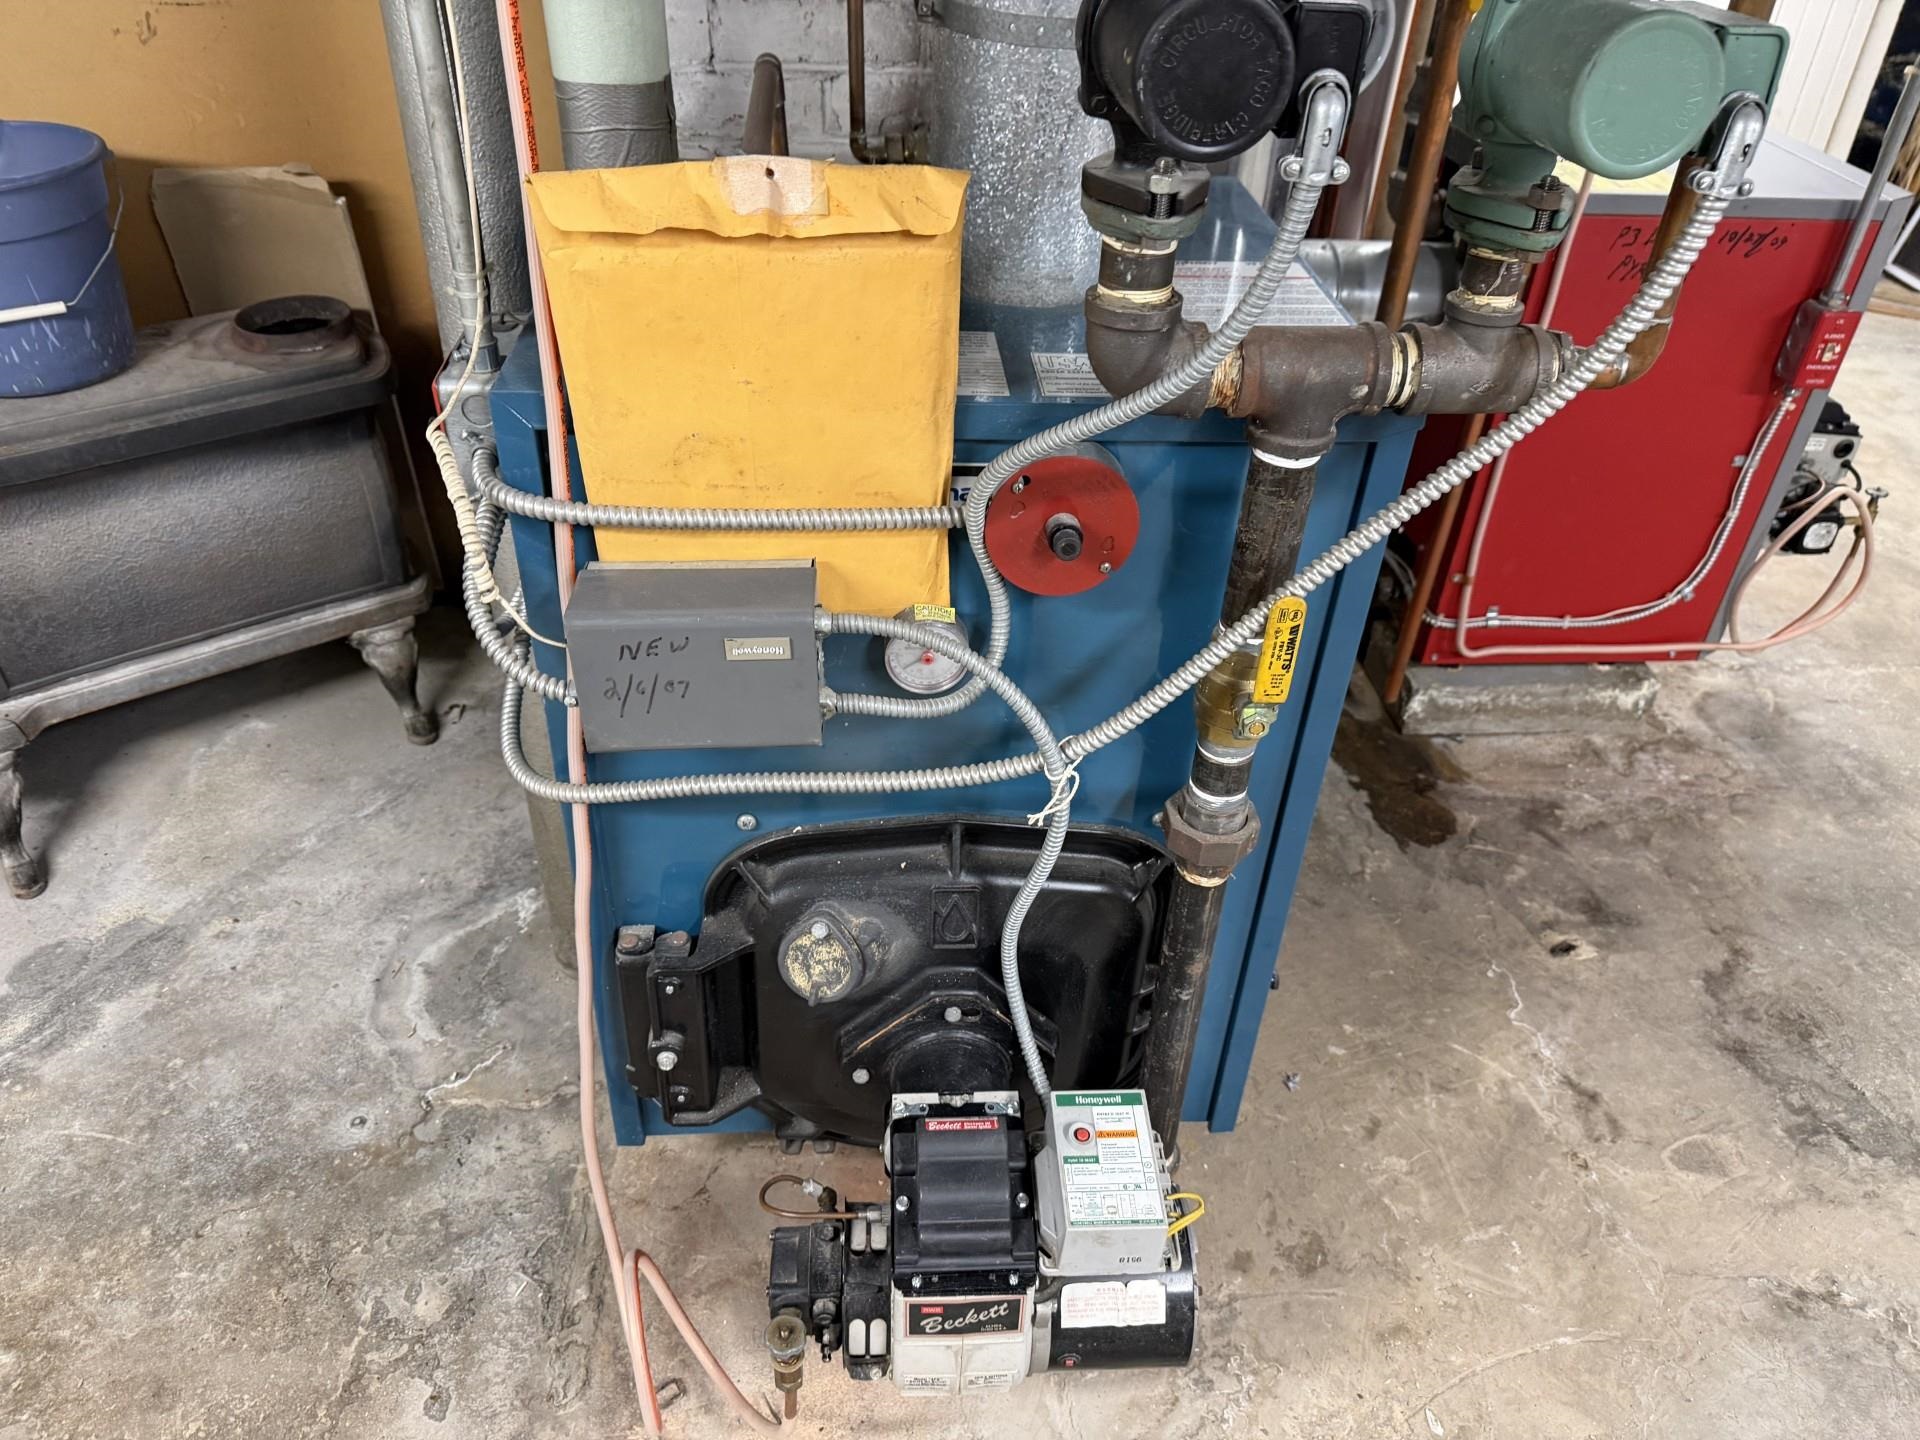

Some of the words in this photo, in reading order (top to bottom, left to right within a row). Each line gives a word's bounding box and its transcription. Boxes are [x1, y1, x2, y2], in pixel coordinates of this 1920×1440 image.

[915, 604, 953, 616] CAUTION
[618, 636, 690, 661] NEW
[731, 645, 785, 657] Honeywell
[1075, 1095, 1122, 1104] Honeywell
[928, 1121, 962, 1130] Beckett
[1106, 1130, 1135, 1138] WARNING
[920, 1302, 1010, 1334] Beckett
